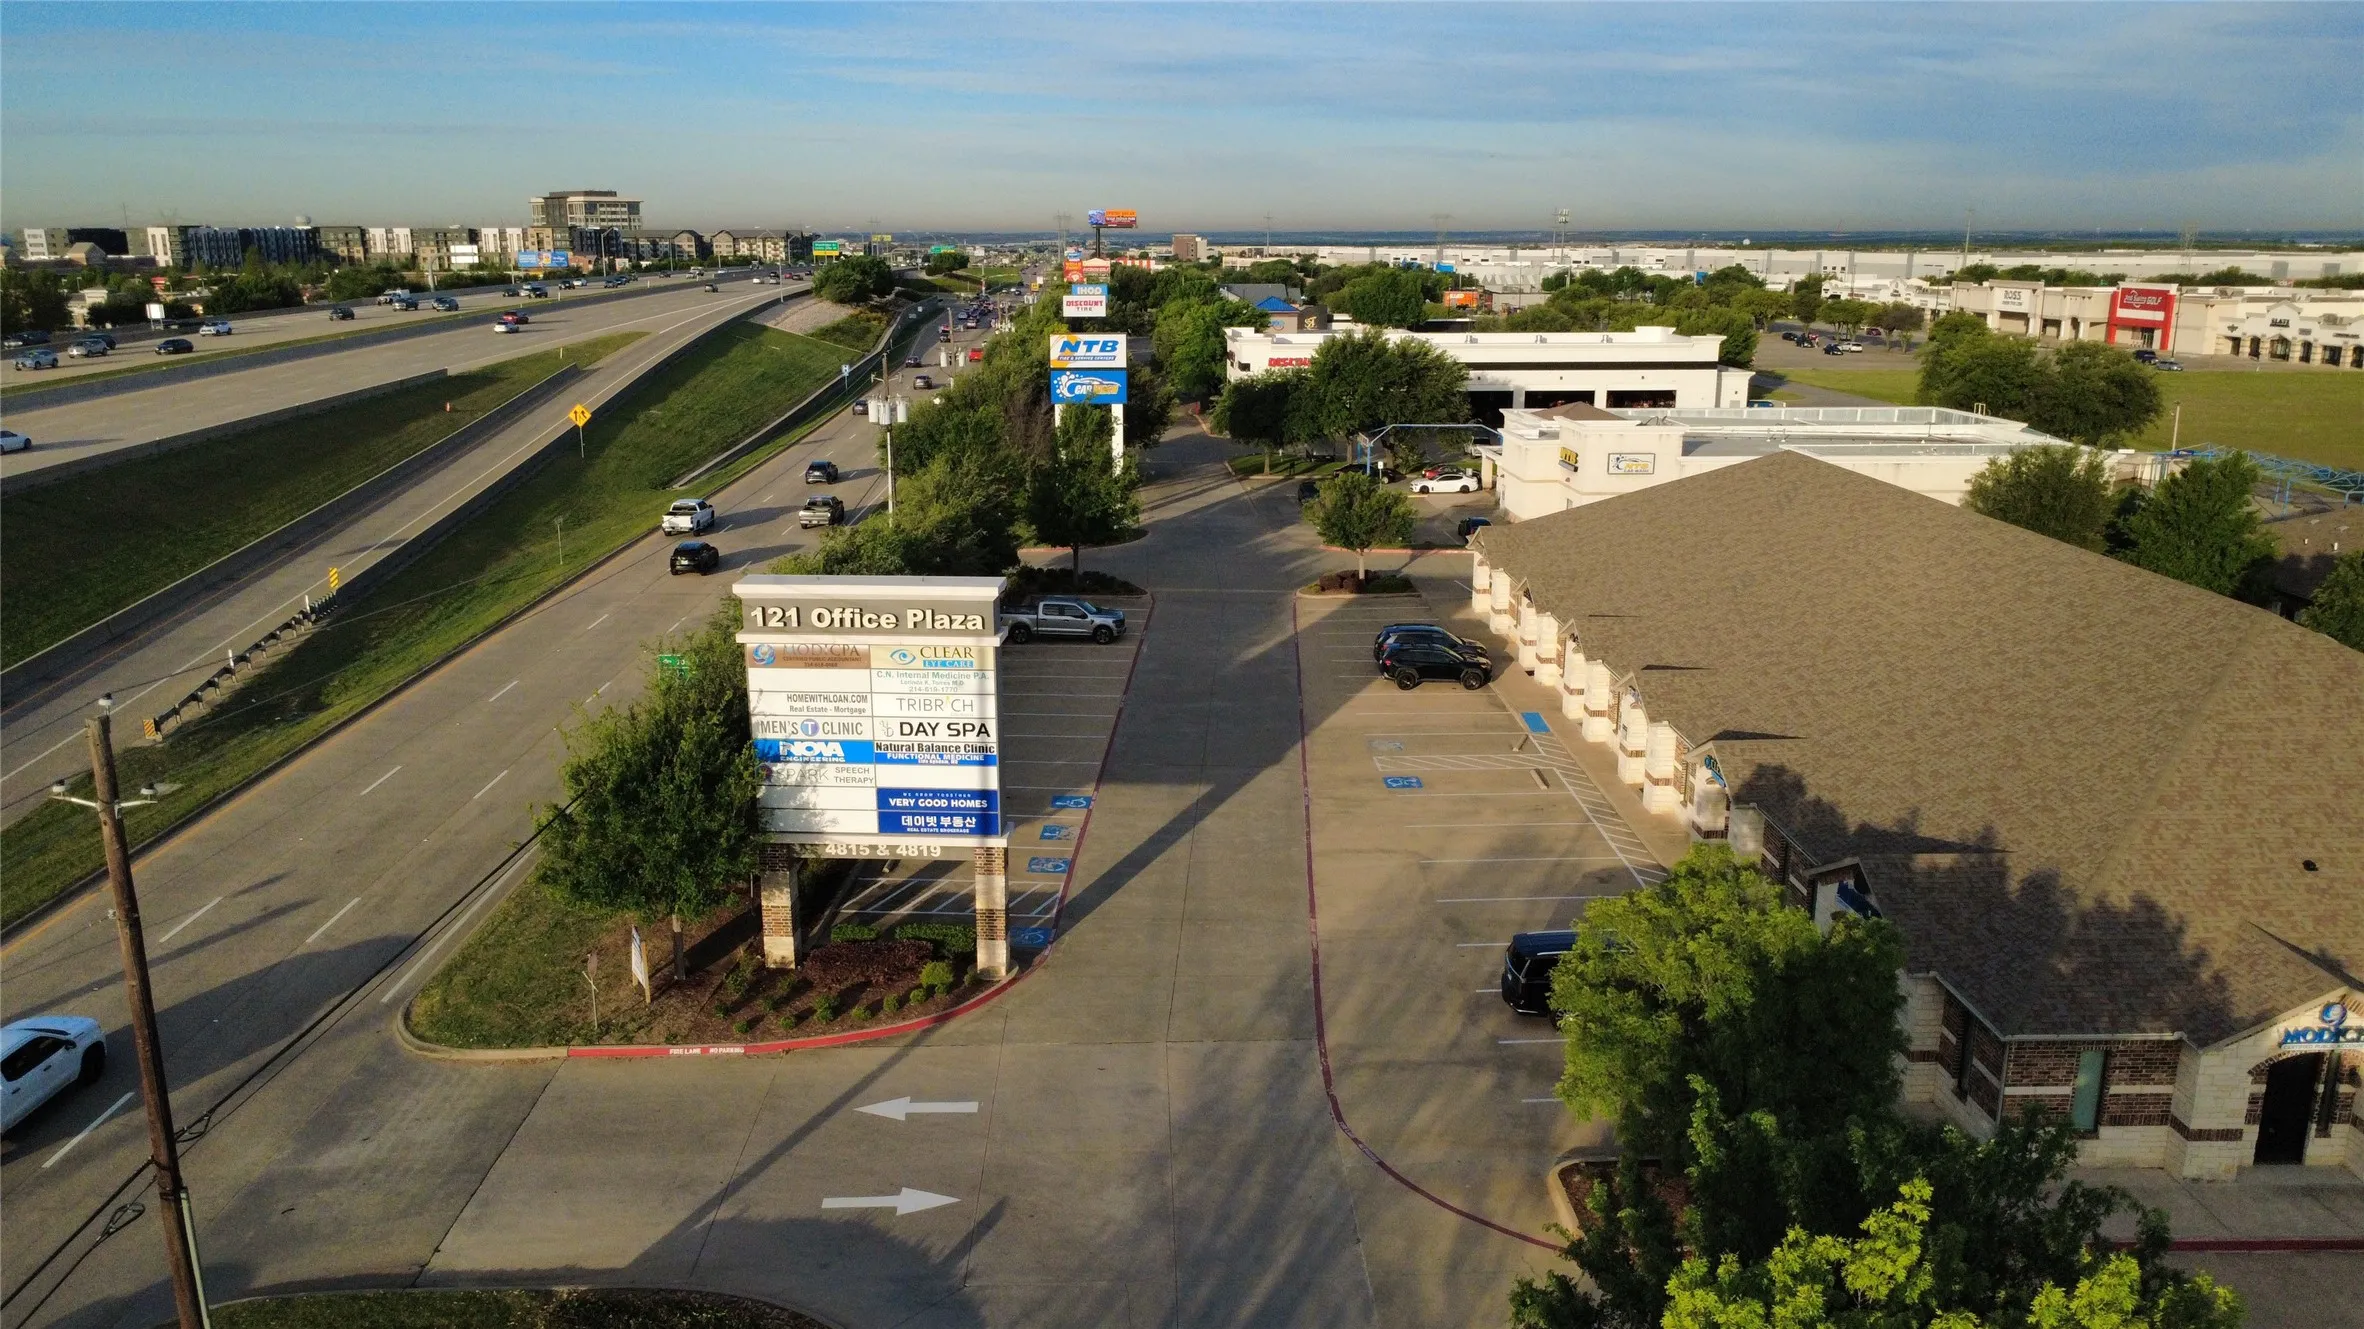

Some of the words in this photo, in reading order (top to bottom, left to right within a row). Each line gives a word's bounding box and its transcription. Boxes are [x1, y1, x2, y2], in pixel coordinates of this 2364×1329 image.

[1059, 340, 1119, 353] NTB
[751, 606, 799, 628] 121
[811, 607, 898, 629] Office
[907, 608, 985, 630] Plaza
[920, 647, 974, 659] CLEAR
[925, 660, 942, 668] EYE
[876, 670, 894, 679] C.N.
[897, 671, 930, 679] Internal
[932, 671, 971, 680] Medicine
[973, 672, 989, 680] P.A.
[787, 693, 868, 704] HOMEWITHLOAN.COM
[834, 706, 867, 714] Mortgage
[760, 720, 799, 735] MEN'S
[822, 721, 863, 735] CLINIC
[900, 721, 940, 737] DAY
[947, 722, 991, 738] SPA
[875, 742, 914, 752] Natural
[917, 743, 961, 753] Balance
[963, 743, 996, 753] Clinic
[775, 767, 830, 781] SPARK
[835, 766, 870, 774] SPEECH
[834, 776, 874, 784] THERAPY
[888, 798, 916, 807] VERY
[918, 799, 948, 808] GOOD
[950, 799, 988, 808] HOMES
[901, 815, 938, 828] 데이빗
[940, 816, 977, 828] 부동산
[825, 843, 870, 856] 4815
[876, 844, 890, 856] &
[895, 845, 942, 857] 4819
[719, 1046, 745, 1054] PARKING
